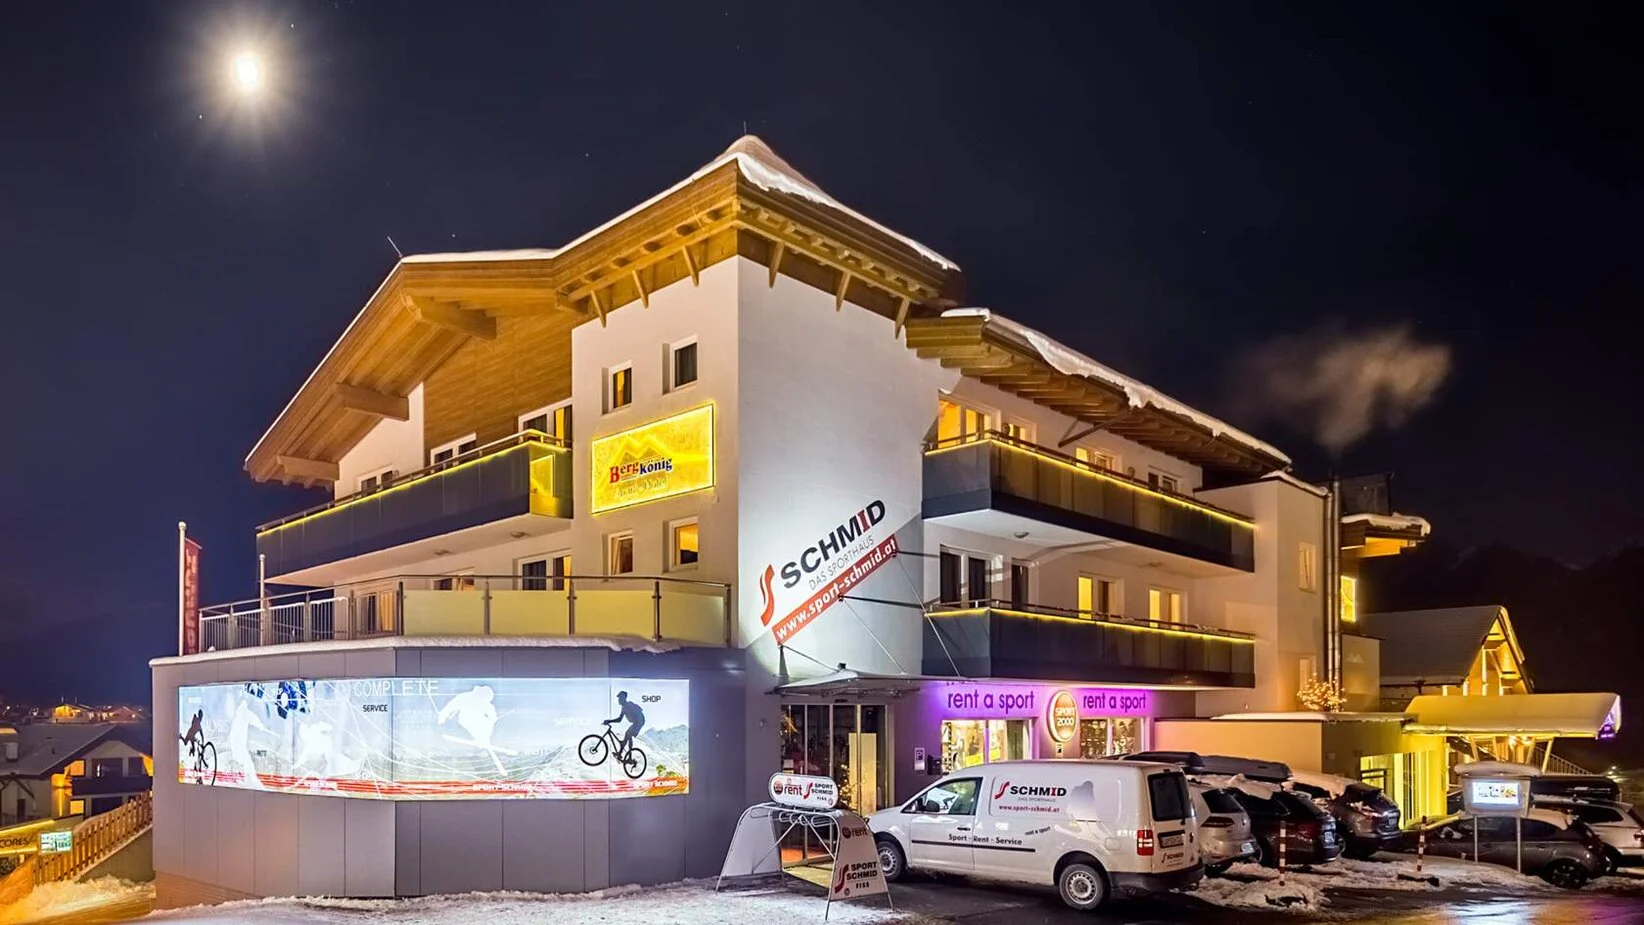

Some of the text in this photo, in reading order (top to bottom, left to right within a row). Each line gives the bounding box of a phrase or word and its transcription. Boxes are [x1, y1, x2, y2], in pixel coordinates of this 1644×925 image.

[609, 457, 673, 484] Bergkönig
[781, 500, 886, 589] SCHMID
[809, 535, 875, 590] DAS SPORTHAUS
[776, 538, 897, 640] www.sport-schmid.at
[354, 680, 439, 696] COMPLETE
[641, 695, 662, 703] SHOP
[948, 691, 1035, 714] rent a sport
[1083, 692, 1147, 713] rent a sport
[362, 704, 388, 712] SERVICE
[1056, 707, 1075, 716] SPORT
[1057, 717, 1075, 727] 2000
[917, 750, 923, 760] P
[784, 785, 803, 796] rent
[1010, 786, 1067, 797] SCHMID
[999, 805, 1060, 813] www.sport-schmid.at
[852, 828, 868, 837] rent
[948, 833, 1022, 845] Sport Rent Service
[851, 861, 877, 870] SPORT
[847, 870, 877, 880] SCHMID
